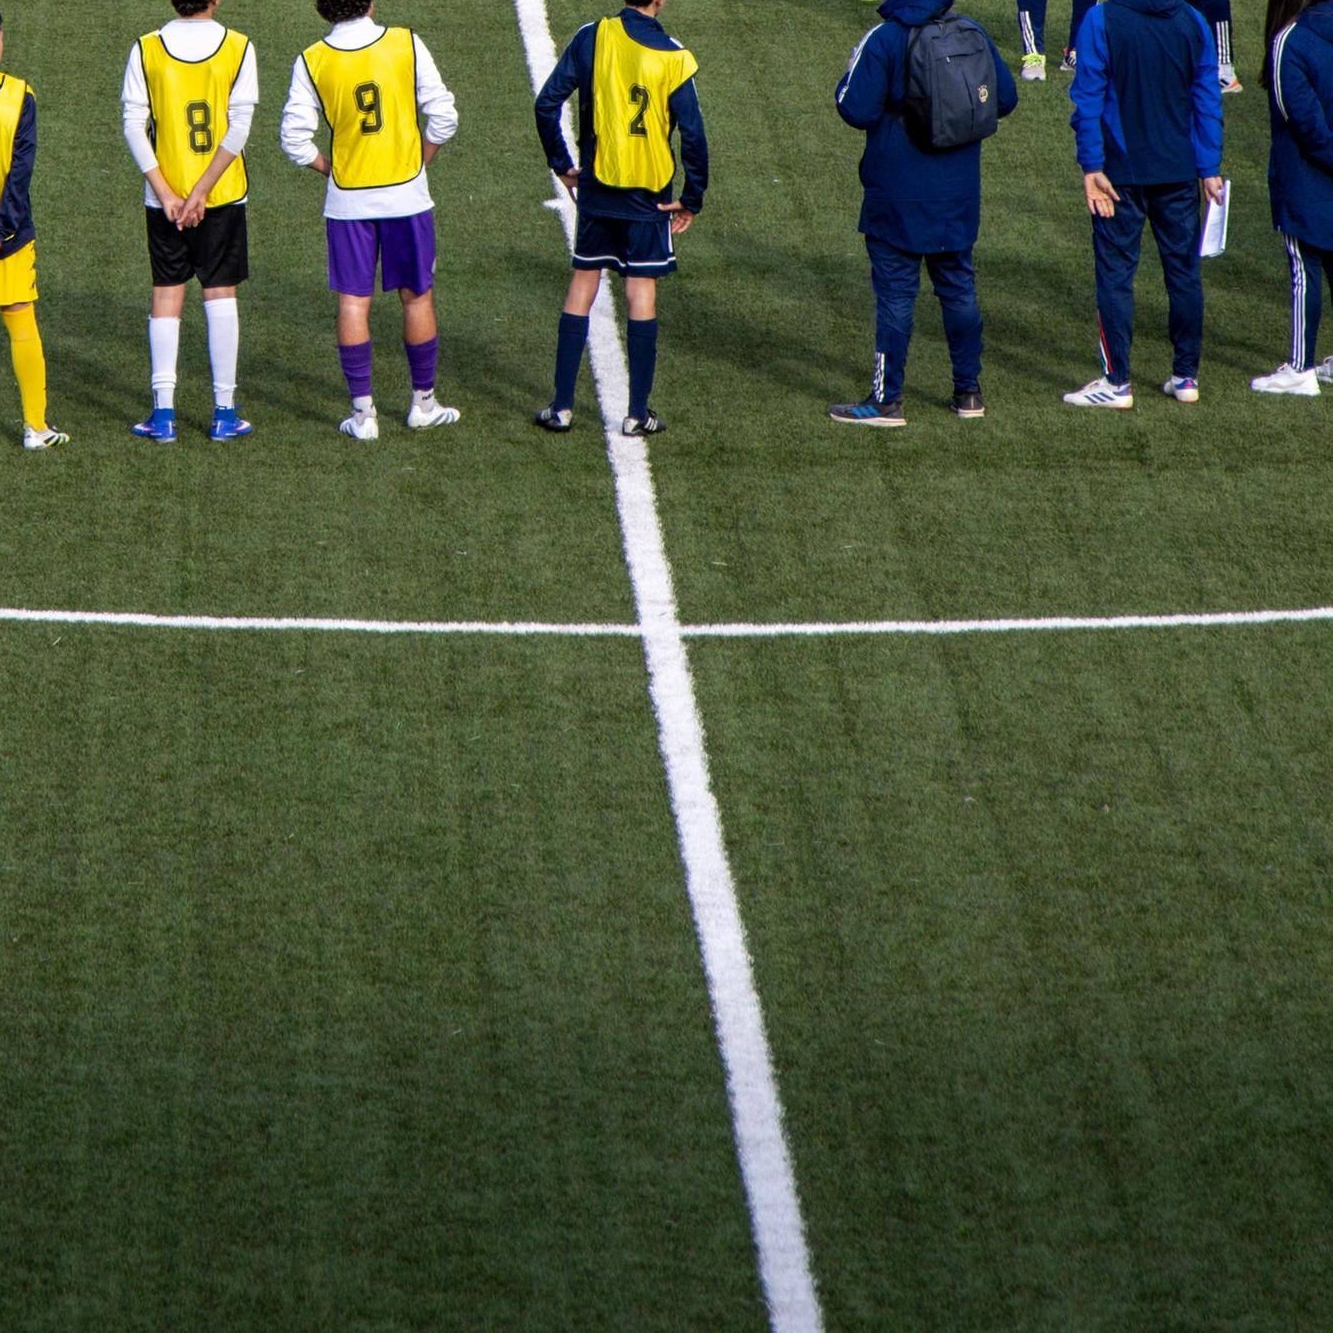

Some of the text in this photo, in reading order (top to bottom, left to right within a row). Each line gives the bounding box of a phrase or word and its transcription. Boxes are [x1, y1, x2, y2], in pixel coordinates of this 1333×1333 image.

[184, 99, 213, 155] 8
[353, 79, 384, 137] 9
[628, 82, 651, 139] 2
